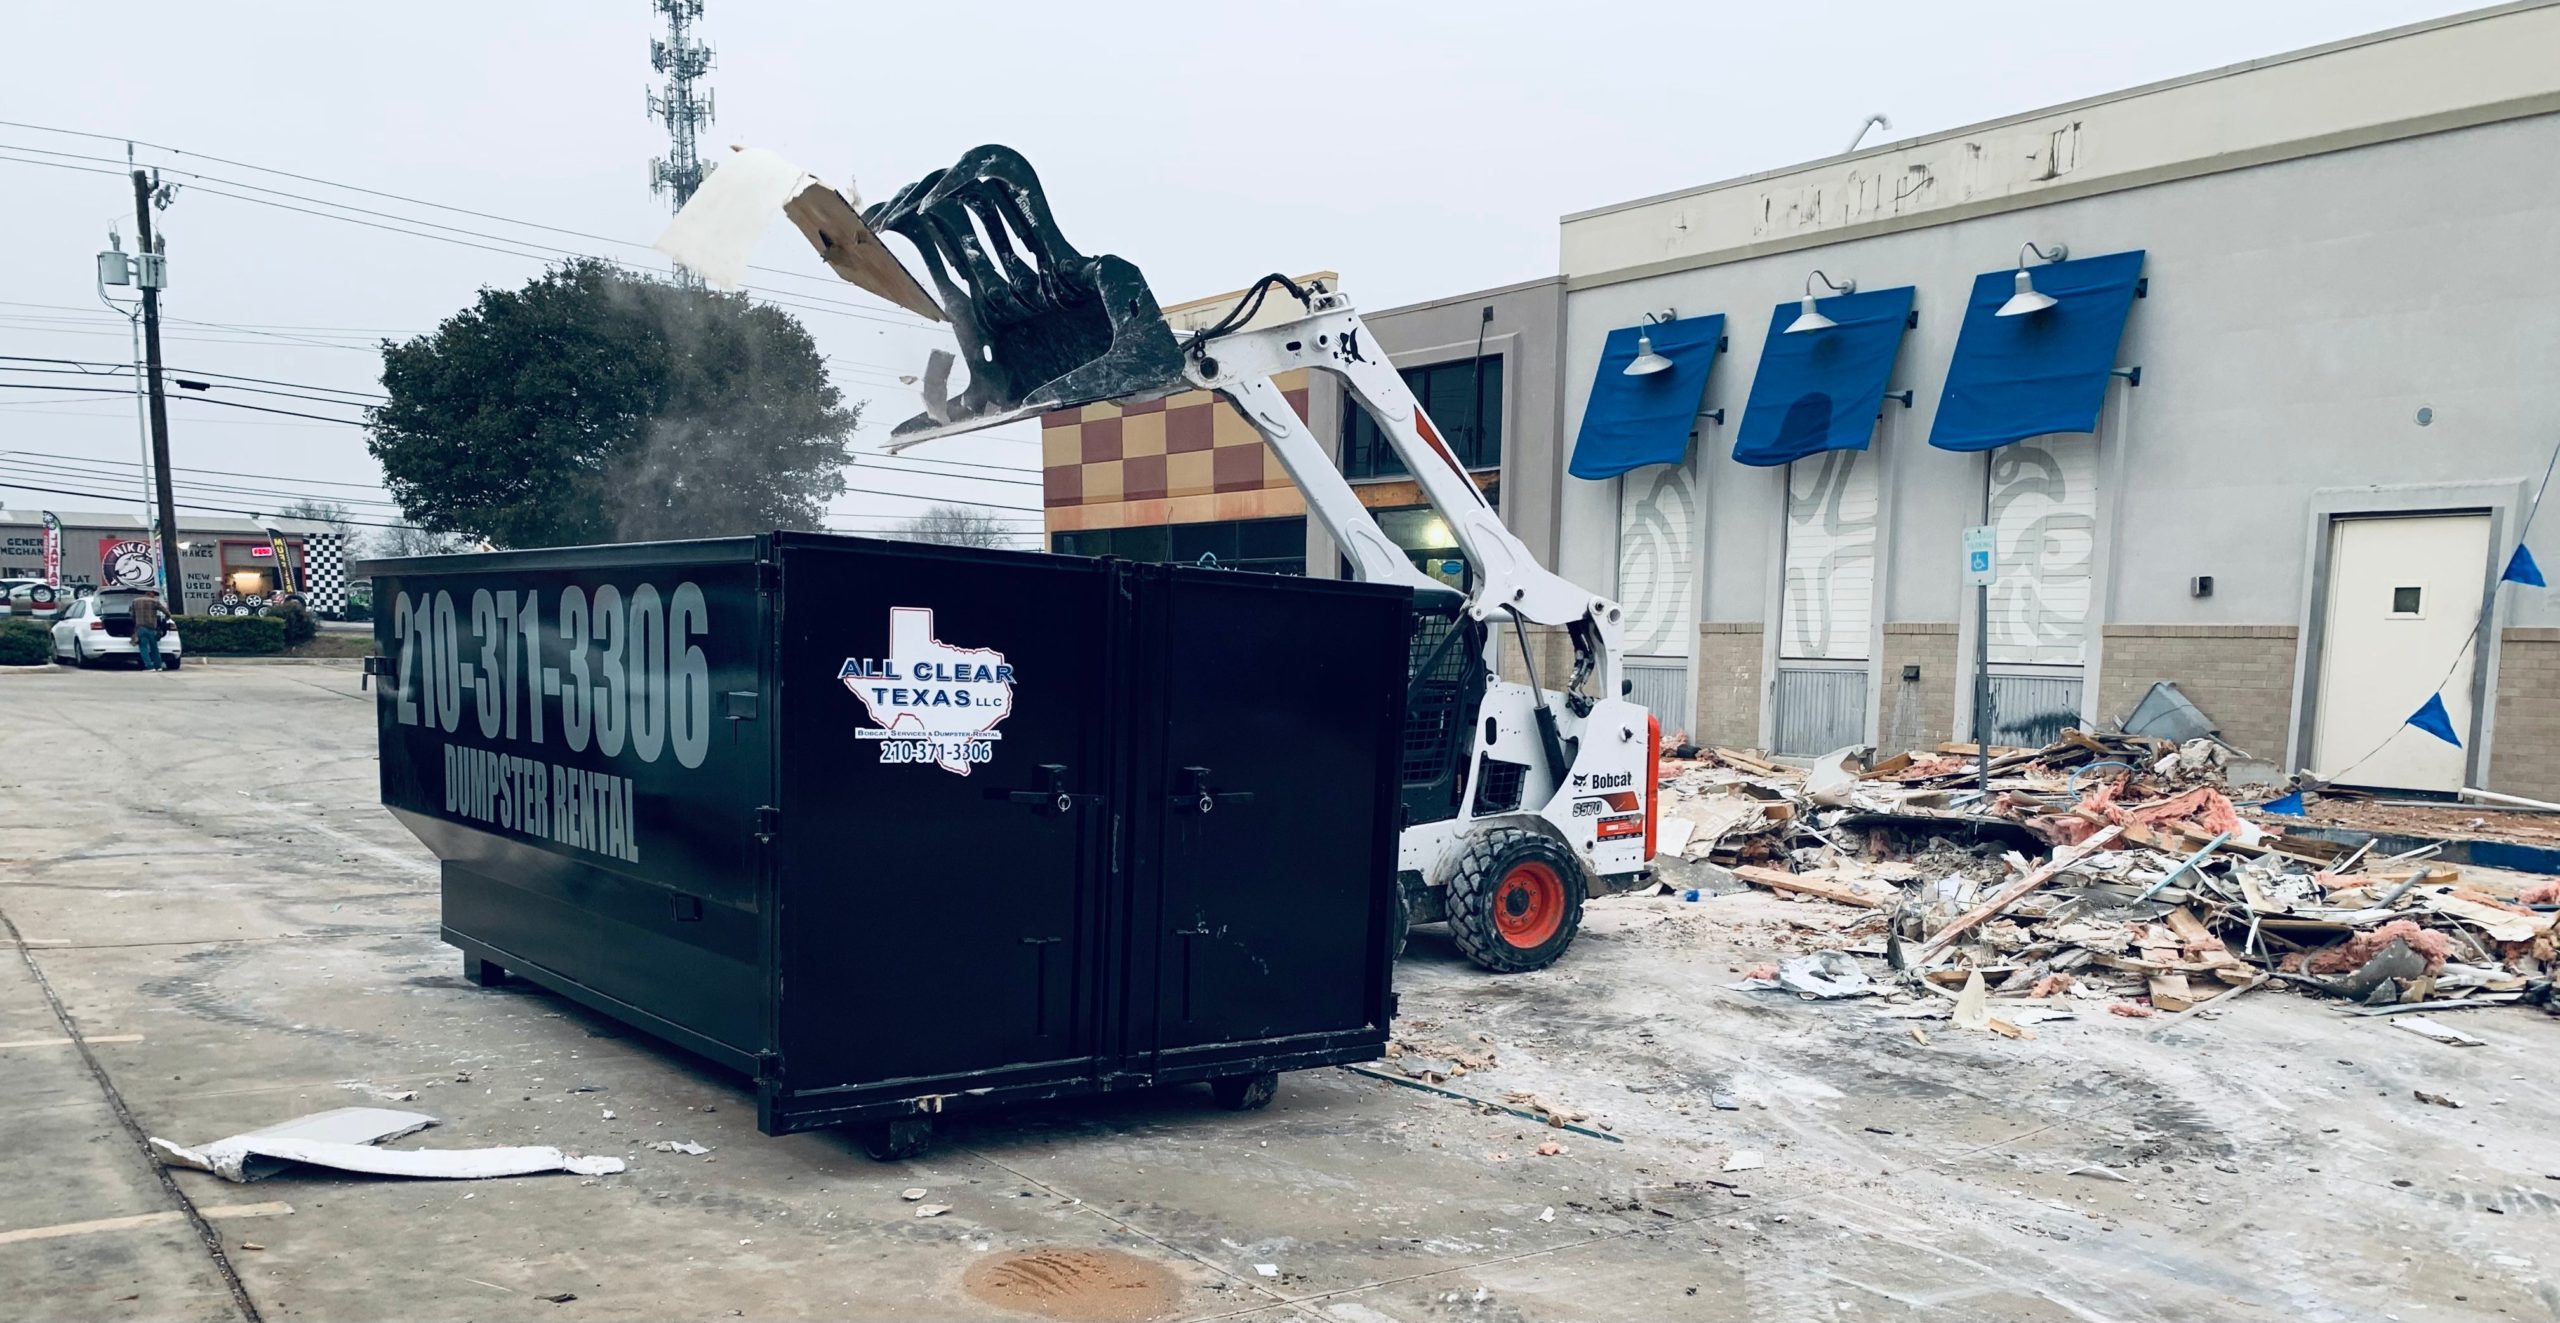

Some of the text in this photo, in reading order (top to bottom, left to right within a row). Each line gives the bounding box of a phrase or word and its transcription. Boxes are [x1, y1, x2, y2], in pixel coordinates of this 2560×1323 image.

[7, 538, 44, 546] GENER
[61, 575, 90, 583] FLAT
[186, 582, 212, 590] USED
[394, 581, 709, 769] 210-371-3306
[841, 659, 1017, 685] ALL CLEAR
[872, 687, 1002, 707] TEXAS LLC
[882, 743, 990, 761] 210-371-3306
[1592, 771, 1632, 789] Bobcat
[444, 743, 639, 864] DUMPSTER RENTAL
[1572, 801, 1602, 817] S570
